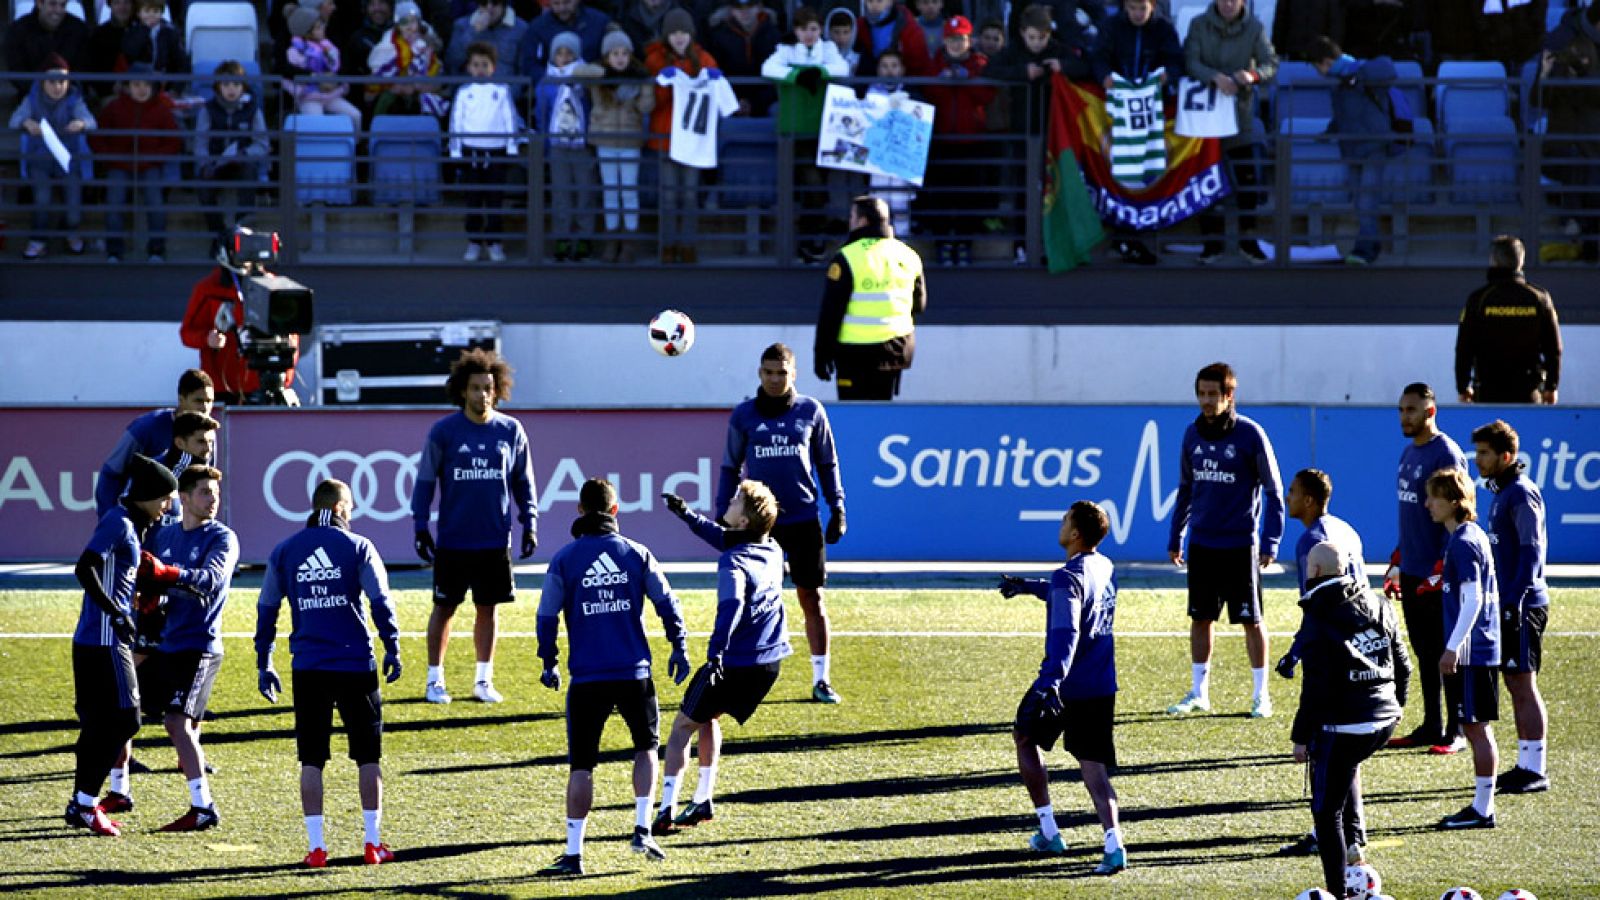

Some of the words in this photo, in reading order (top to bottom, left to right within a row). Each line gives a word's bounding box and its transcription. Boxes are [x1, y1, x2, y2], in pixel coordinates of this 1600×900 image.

[1485, 306, 1537, 317] PROSEGUR
[472, 456, 488, 468] Fly
[872, 434, 1103, 488] Sanitas
[0, 456, 98, 511] Au
[538, 457, 711, 513] Aud
[297, 566, 341, 582] adidas
[582, 570, 628, 588] adidas
[298, 594, 348, 611] Emirates
[582, 599, 631, 616] Emirates
